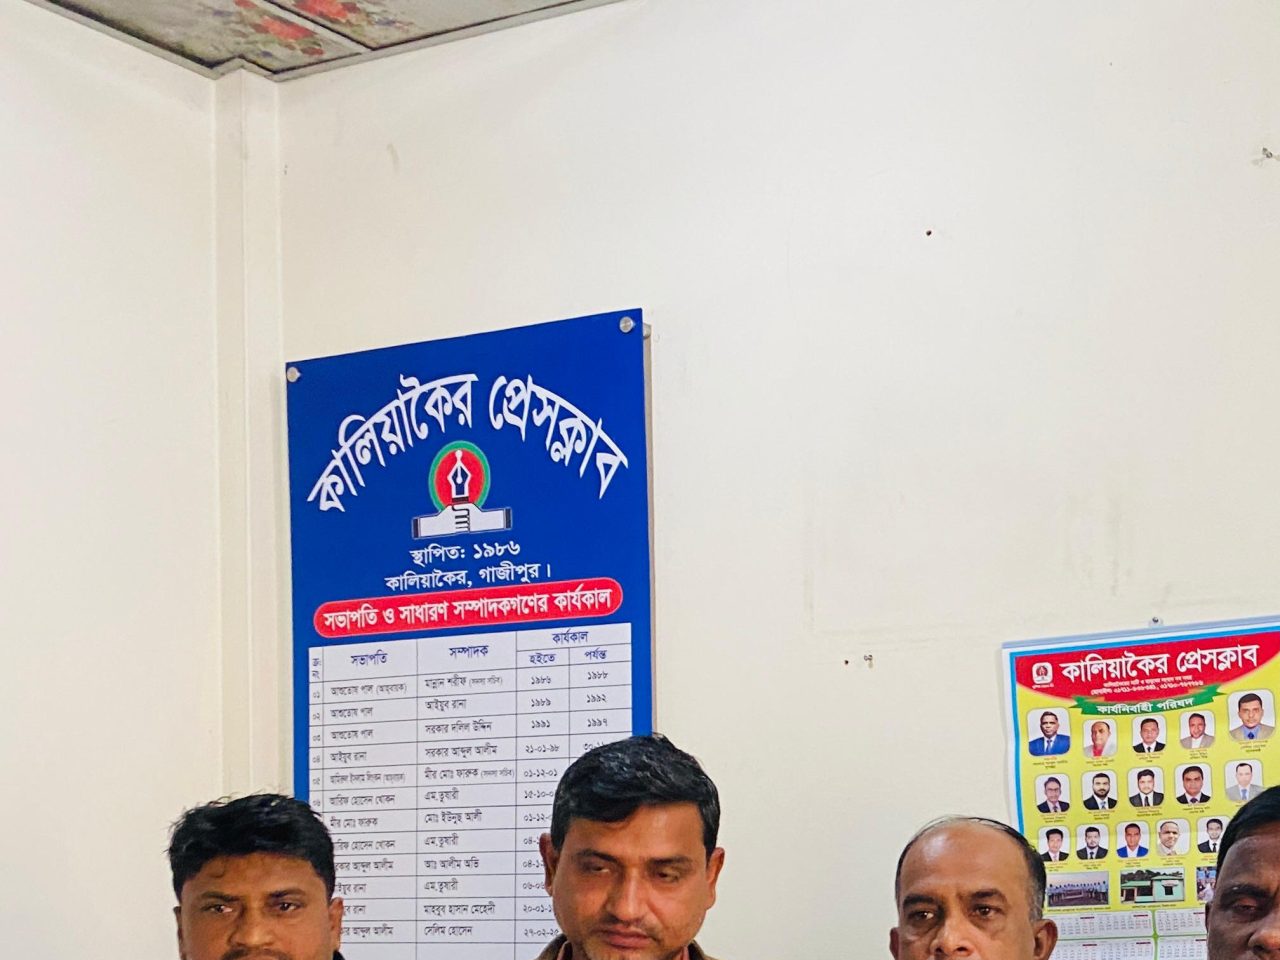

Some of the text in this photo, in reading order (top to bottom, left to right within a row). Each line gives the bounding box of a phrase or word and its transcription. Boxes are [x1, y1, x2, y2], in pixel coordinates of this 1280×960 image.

[307, 374, 628, 512] কালিয়াকৈর প্রেসক্লাব
[474, 542, 520, 559] ১৯৮৬
[385, 566, 472, 591] কালিয়াকৈর,
[325, 587, 612, 631] সভাপতি ও সাধারণ সম্পাদকগণের কার্যকাল
[552, 629, 588, 644] কার্যকাল
[351, 649, 387, 666] সভাপতি
[449, 645, 489, 659] সম্পাদক
[529, 653, 556, 664] হইতে
[584, 647, 608, 660] পর্যন্ত
[1059, 645, 1260, 683] কালিয়াকৈর প্রেসক্লাব
[1156, 697, 1194, 709] পরিষদ
